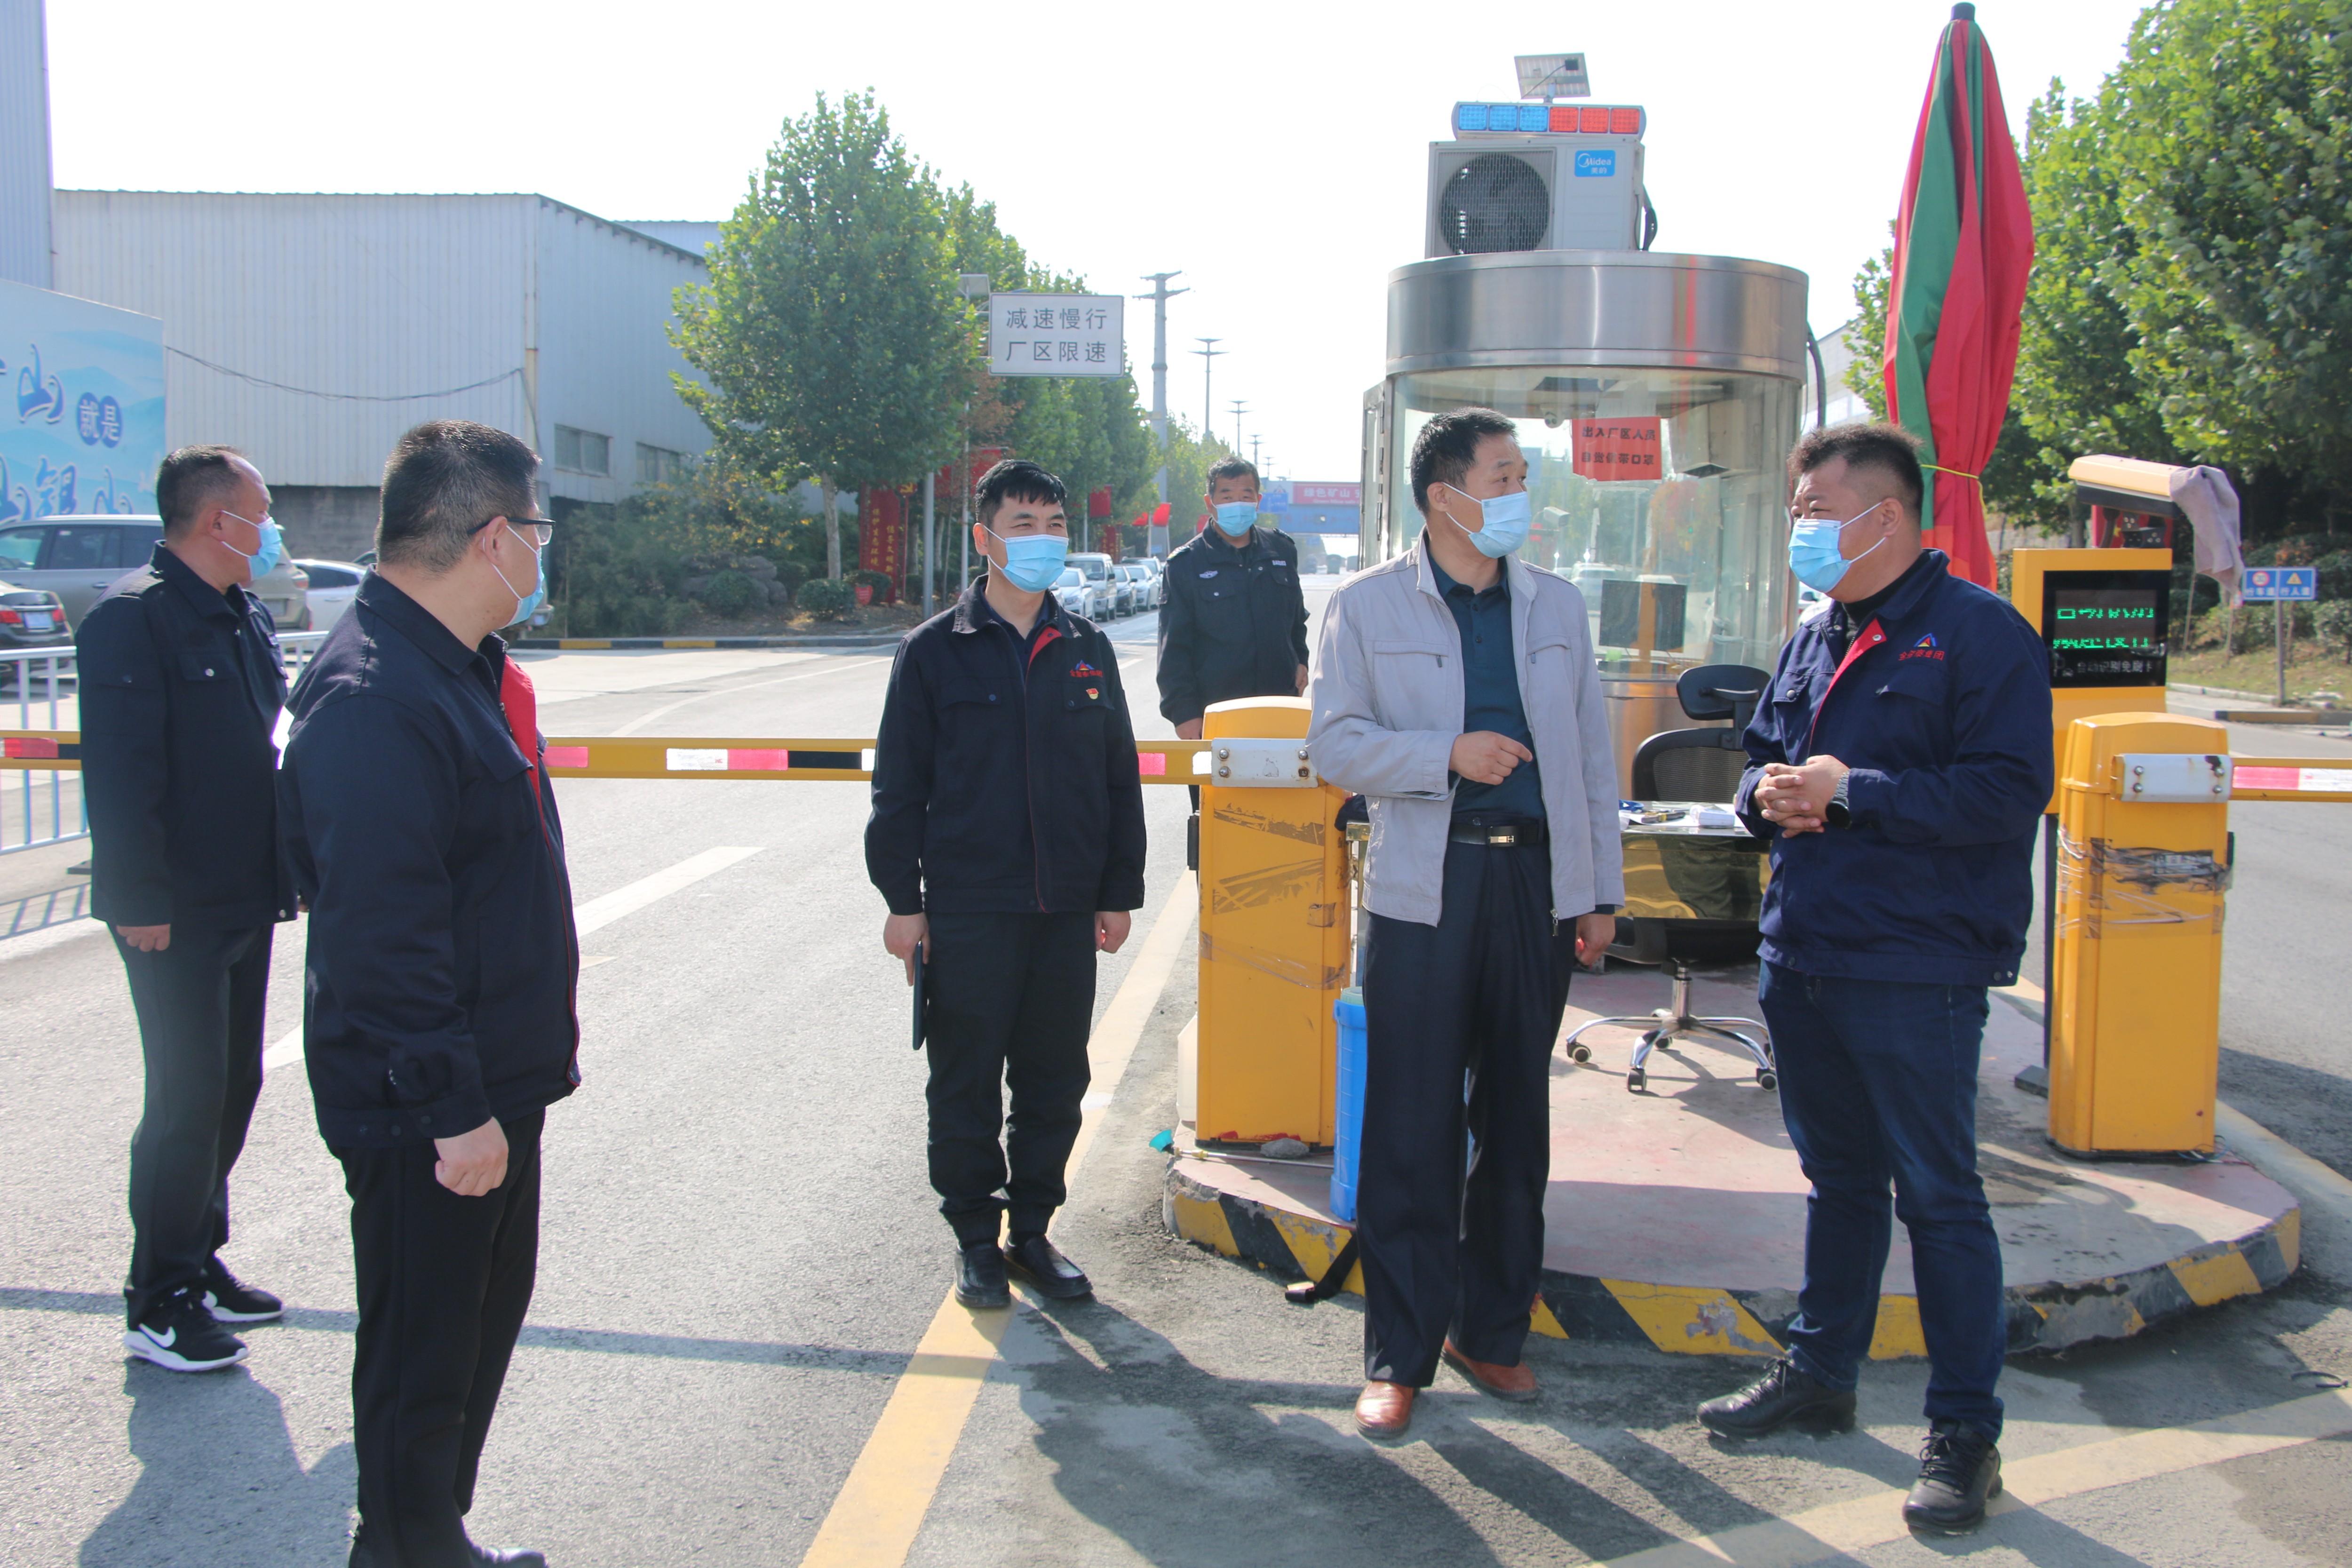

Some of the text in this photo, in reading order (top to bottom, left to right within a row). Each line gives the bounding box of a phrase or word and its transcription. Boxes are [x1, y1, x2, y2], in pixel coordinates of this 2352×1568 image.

[1580, 155, 1612, 167] Midea
[1006, 308, 1107, 329] 减速慢行
[1006, 341, 1106, 362] 厂区限速
[1582, 426, 1656, 440] 出入厂区人员
[1304, 488, 1350, 497] 绿色矿山
